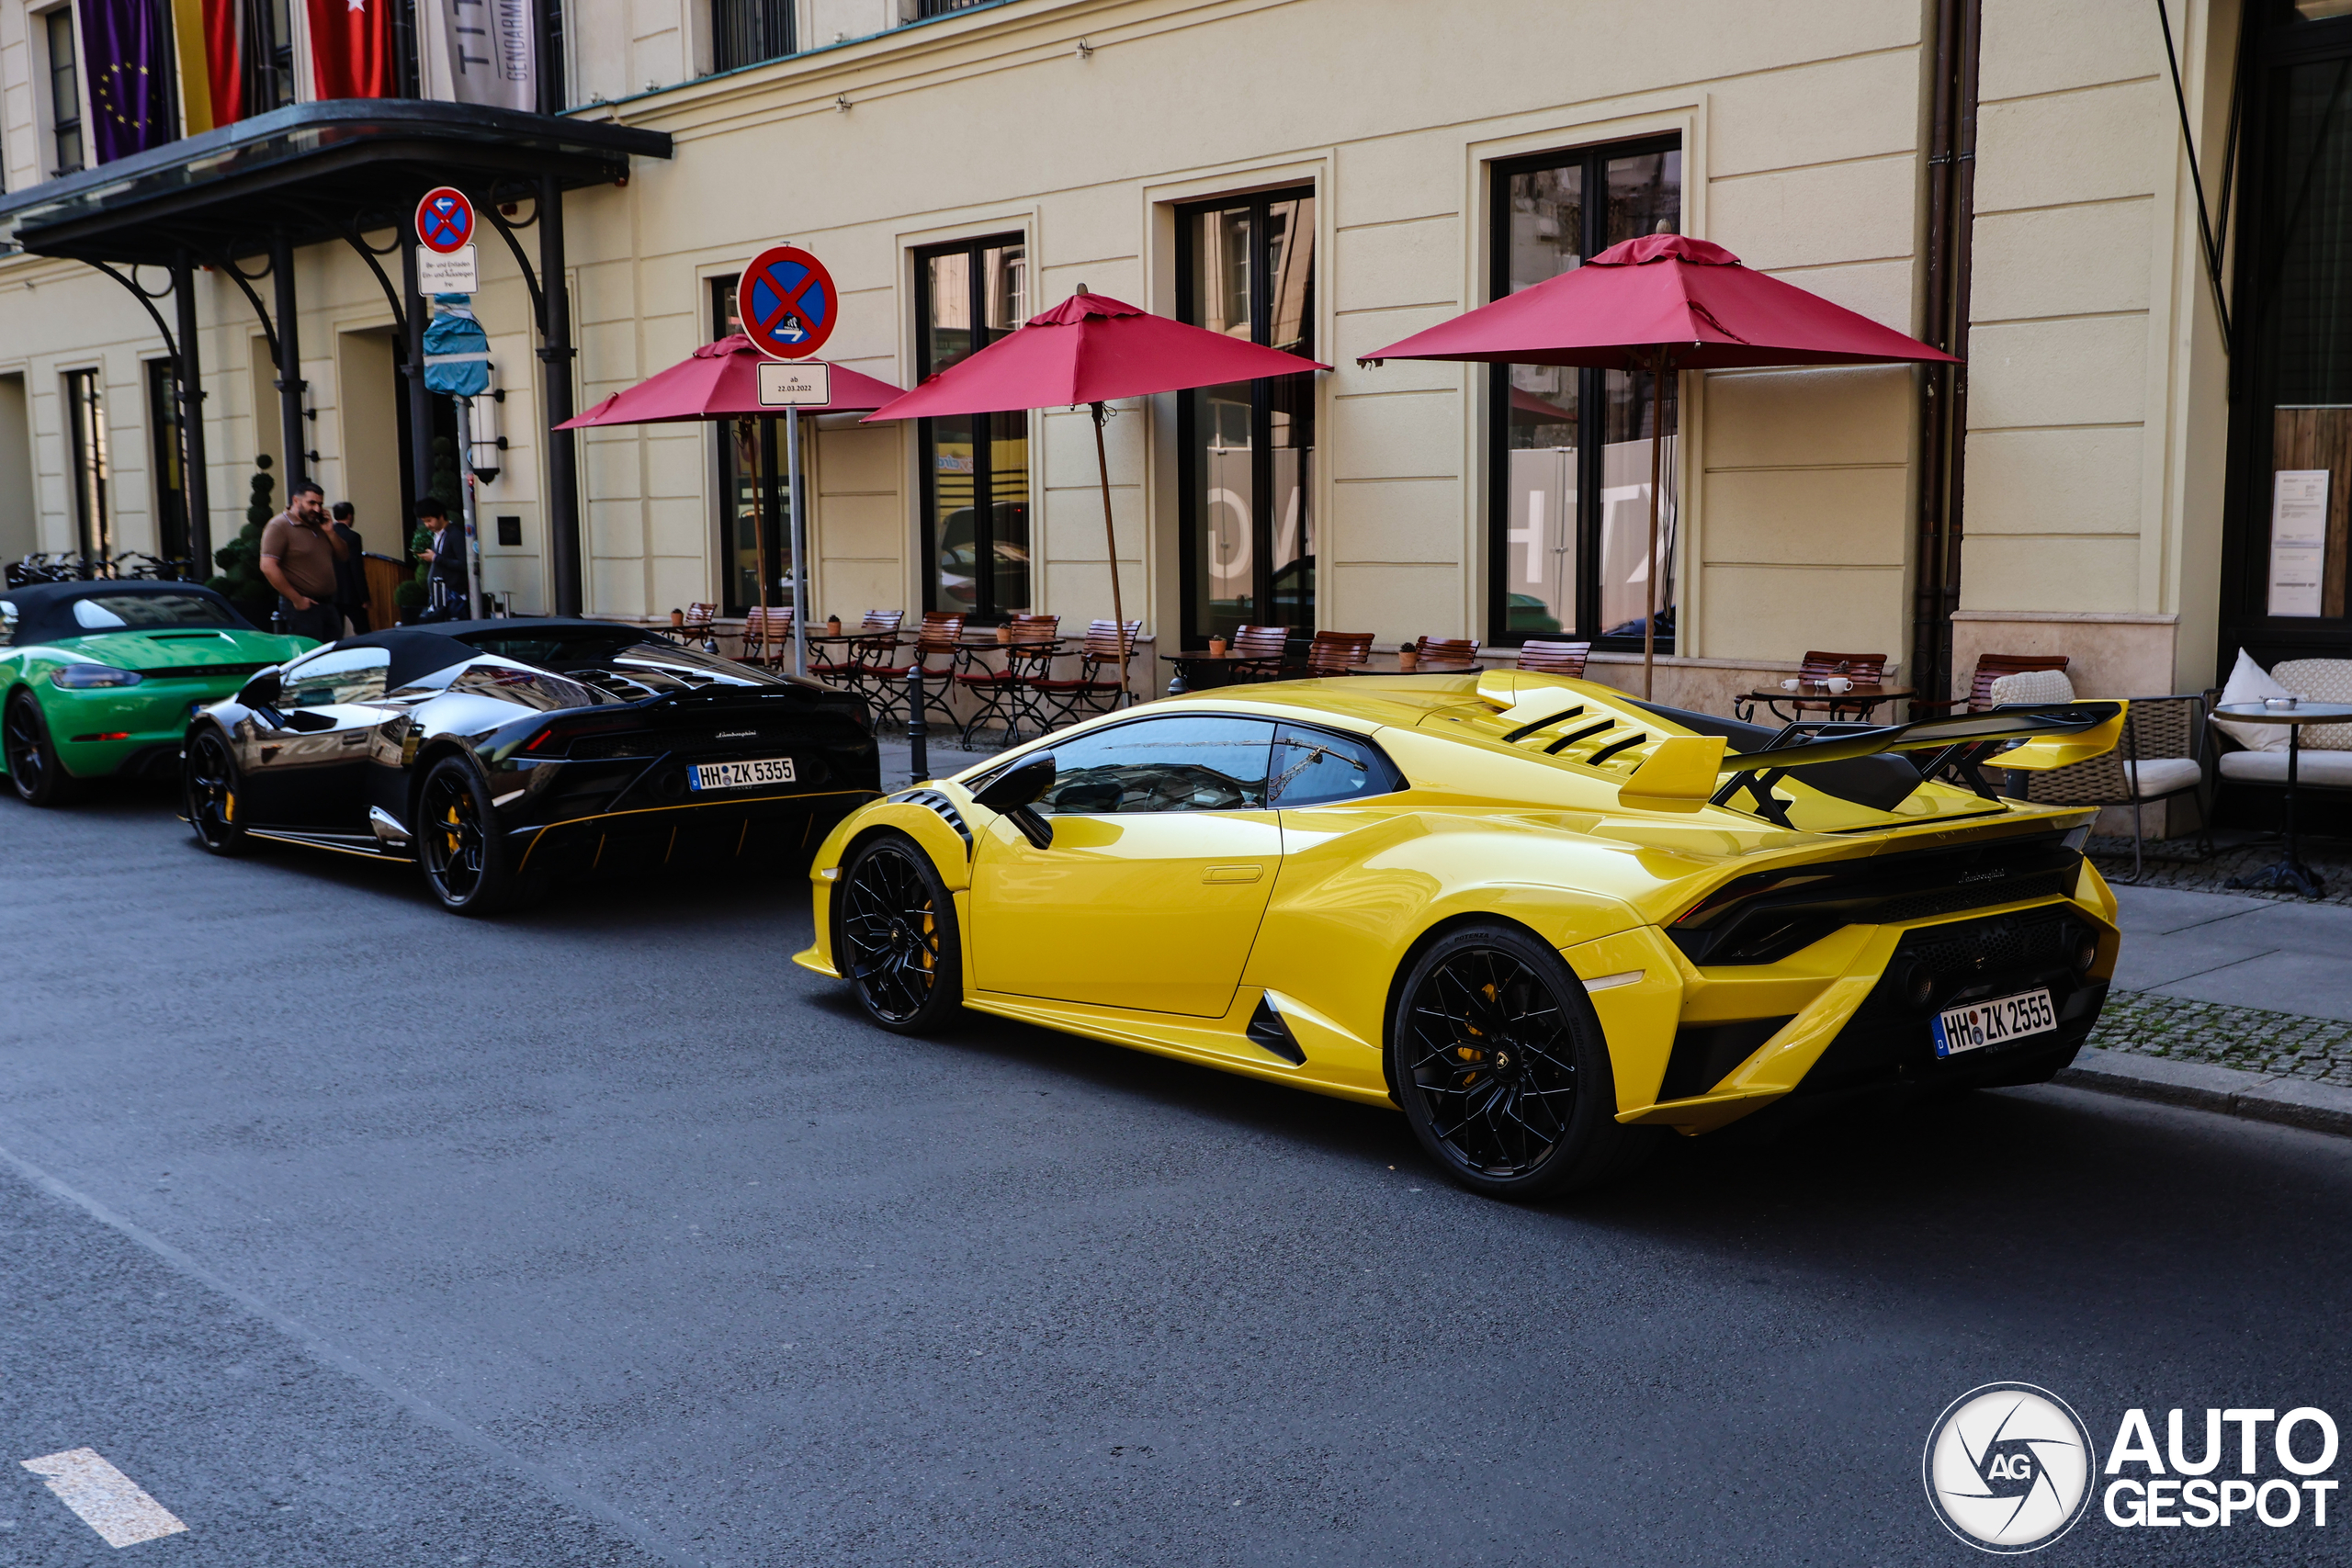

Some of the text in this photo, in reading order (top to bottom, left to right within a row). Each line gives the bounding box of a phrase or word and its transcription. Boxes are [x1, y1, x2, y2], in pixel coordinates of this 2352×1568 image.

[716, 730, 757, 739] Lamborghini
[699, 761, 792, 786] HH ZK 5355
[1454, 932, 1489, 943] POTENZA
[1943, 994, 2052, 1050] HH ZK 2555
